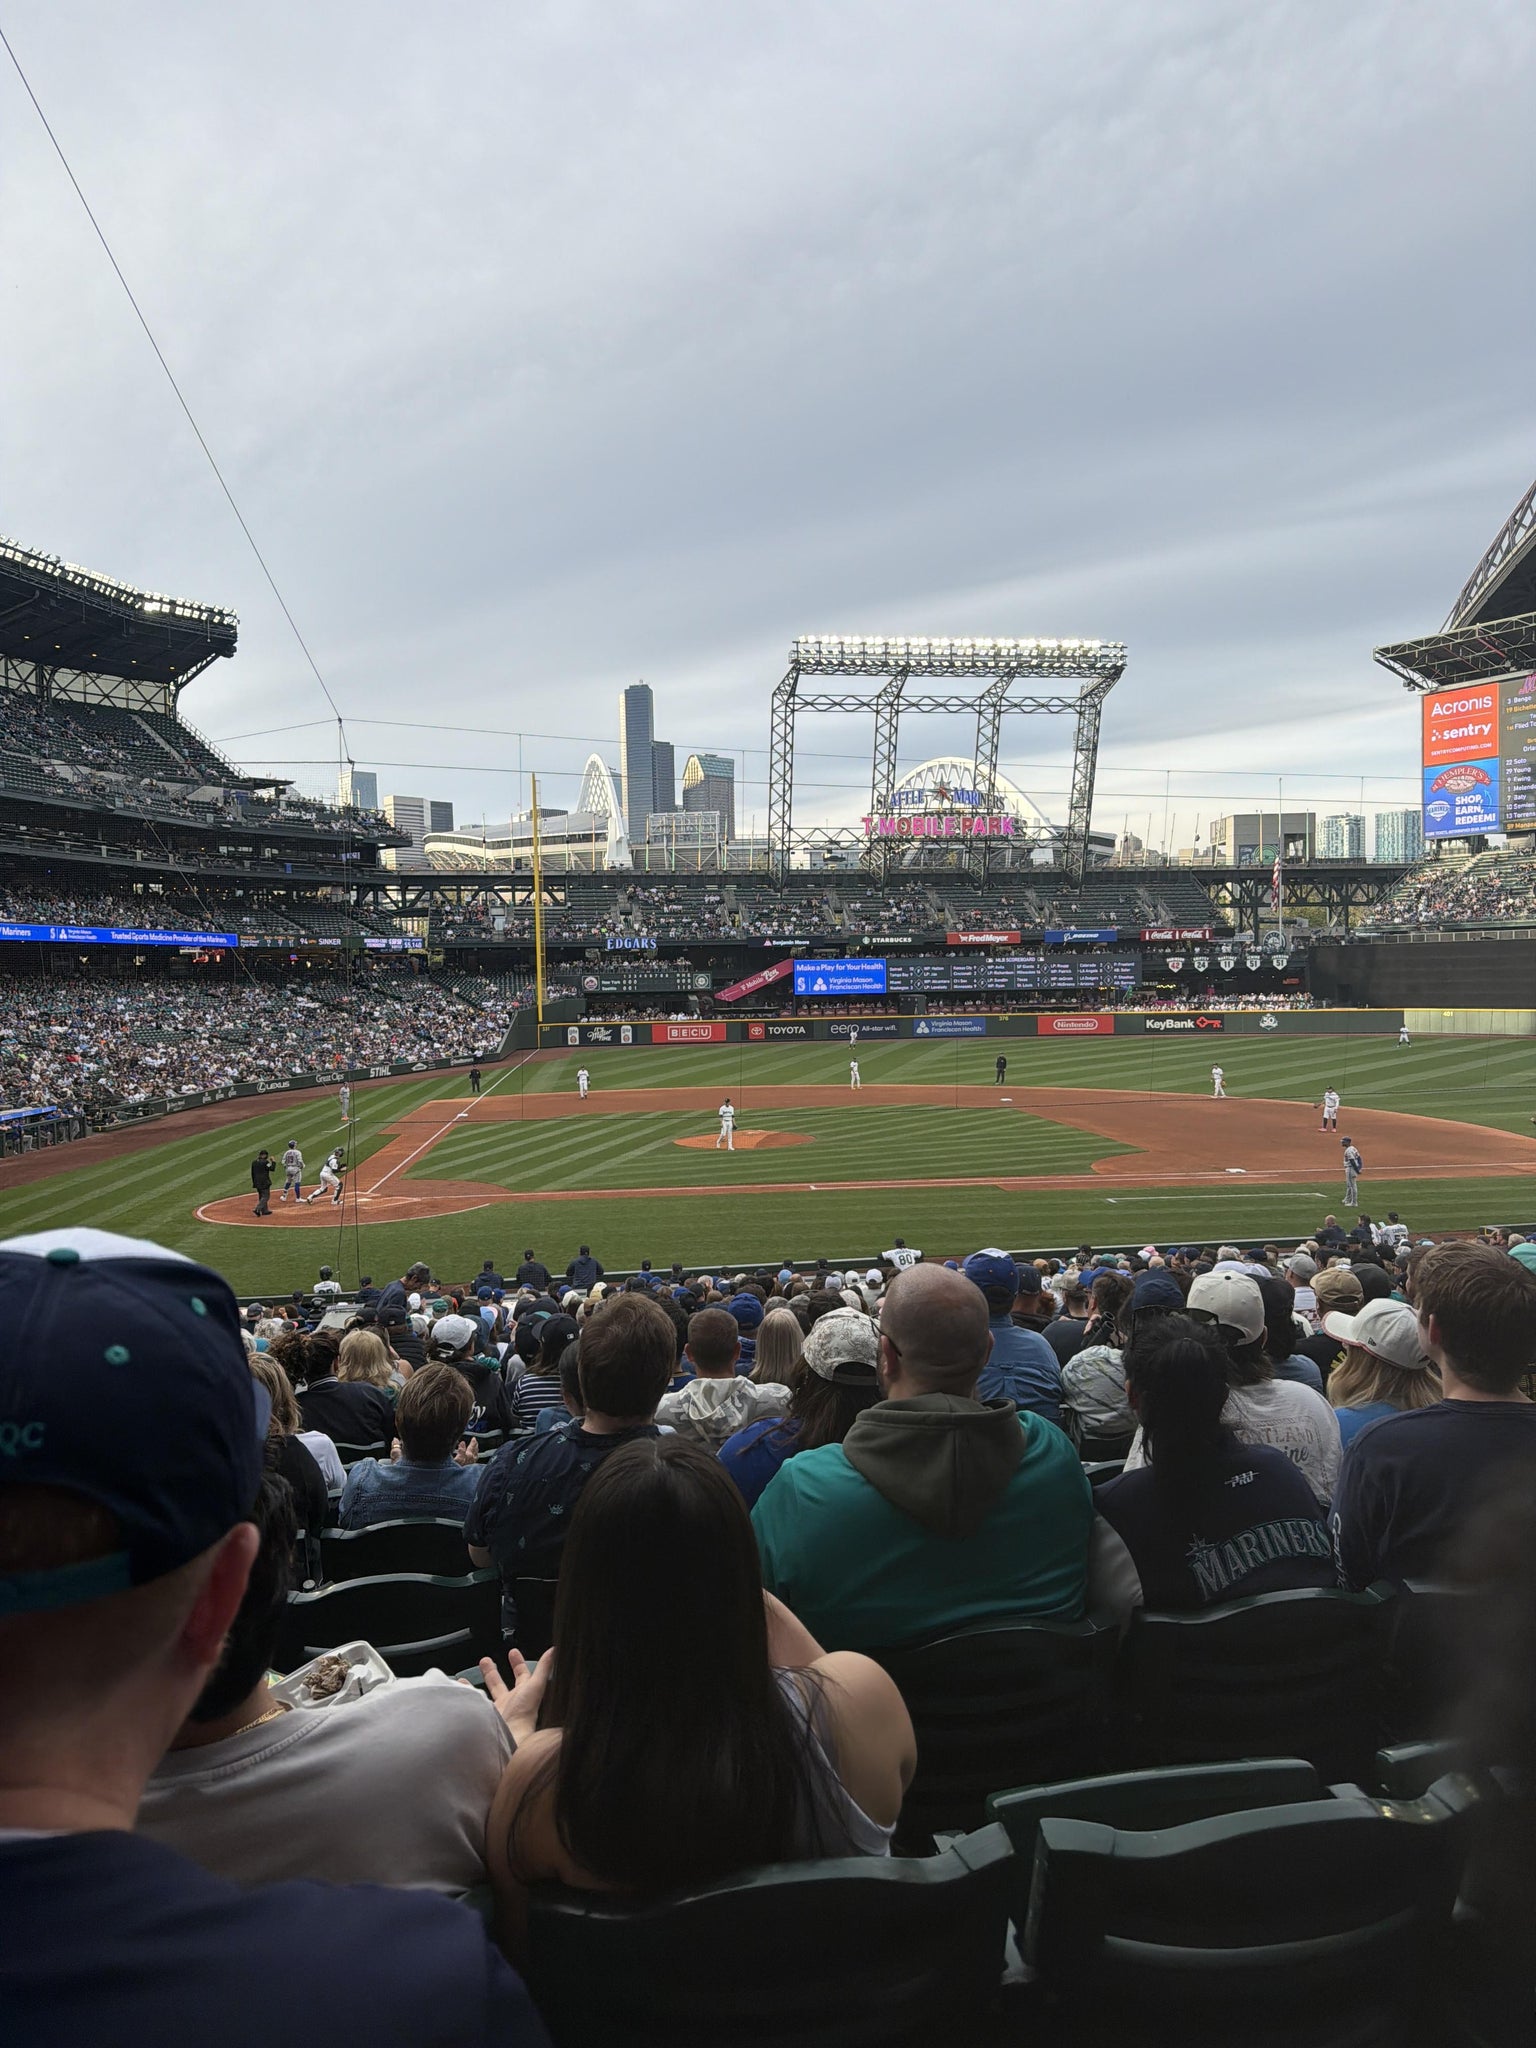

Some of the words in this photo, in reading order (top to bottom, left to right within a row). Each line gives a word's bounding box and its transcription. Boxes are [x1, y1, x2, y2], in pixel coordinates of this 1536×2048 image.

[1443, 723, 1492, 739] sentry
[876, 788, 925, 810] SEATTLE
[952, 786, 1005, 810] MARINERS
[1455, 794, 1483, 805] SHOP,
[1455, 804, 1484, 815] EARN,
[1455, 813, 1496, 825] REDEEM!
[861, 816, 957, 836] T-MOBILE
[961, 816, 1015, 836] PARK
[2, 926, 31, 937] Mariners
[111, 931, 132, 940] Trusted
[150, 933, 173, 941] Medicine
[173, 934, 193, 942] Provider
[299, 937, 308, 945] 94
[318, 937, 341, 946] SINKER
[607, 937, 657, 950] EDGARS
[872, 936, 912, 944] STARBUCKS
[820, 964, 835, 972] Play
[836, 963, 845, 971] for
[861, 962, 884, 970] Health
[1224, 960, 1231, 968] 11
[1249, 960, 1258, 968] 51
[1276, 959, 1284, 967] 51
[829, 977, 852, 985] Virginia
[768, 1025, 806, 1035] TOYOTA
[1056, 1021, 1095, 1029] Nintendo
[1146, 1019, 1195, 1030] KeyBank
[671, 1029, 709, 1037] BECU
[369, 1066, 391, 1078] STIHL
[266, 1081, 290, 1090] LEXUS
[898, 1253, 912, 1265] 80
[1191, 1519, 1331, 1600] MARINERS
